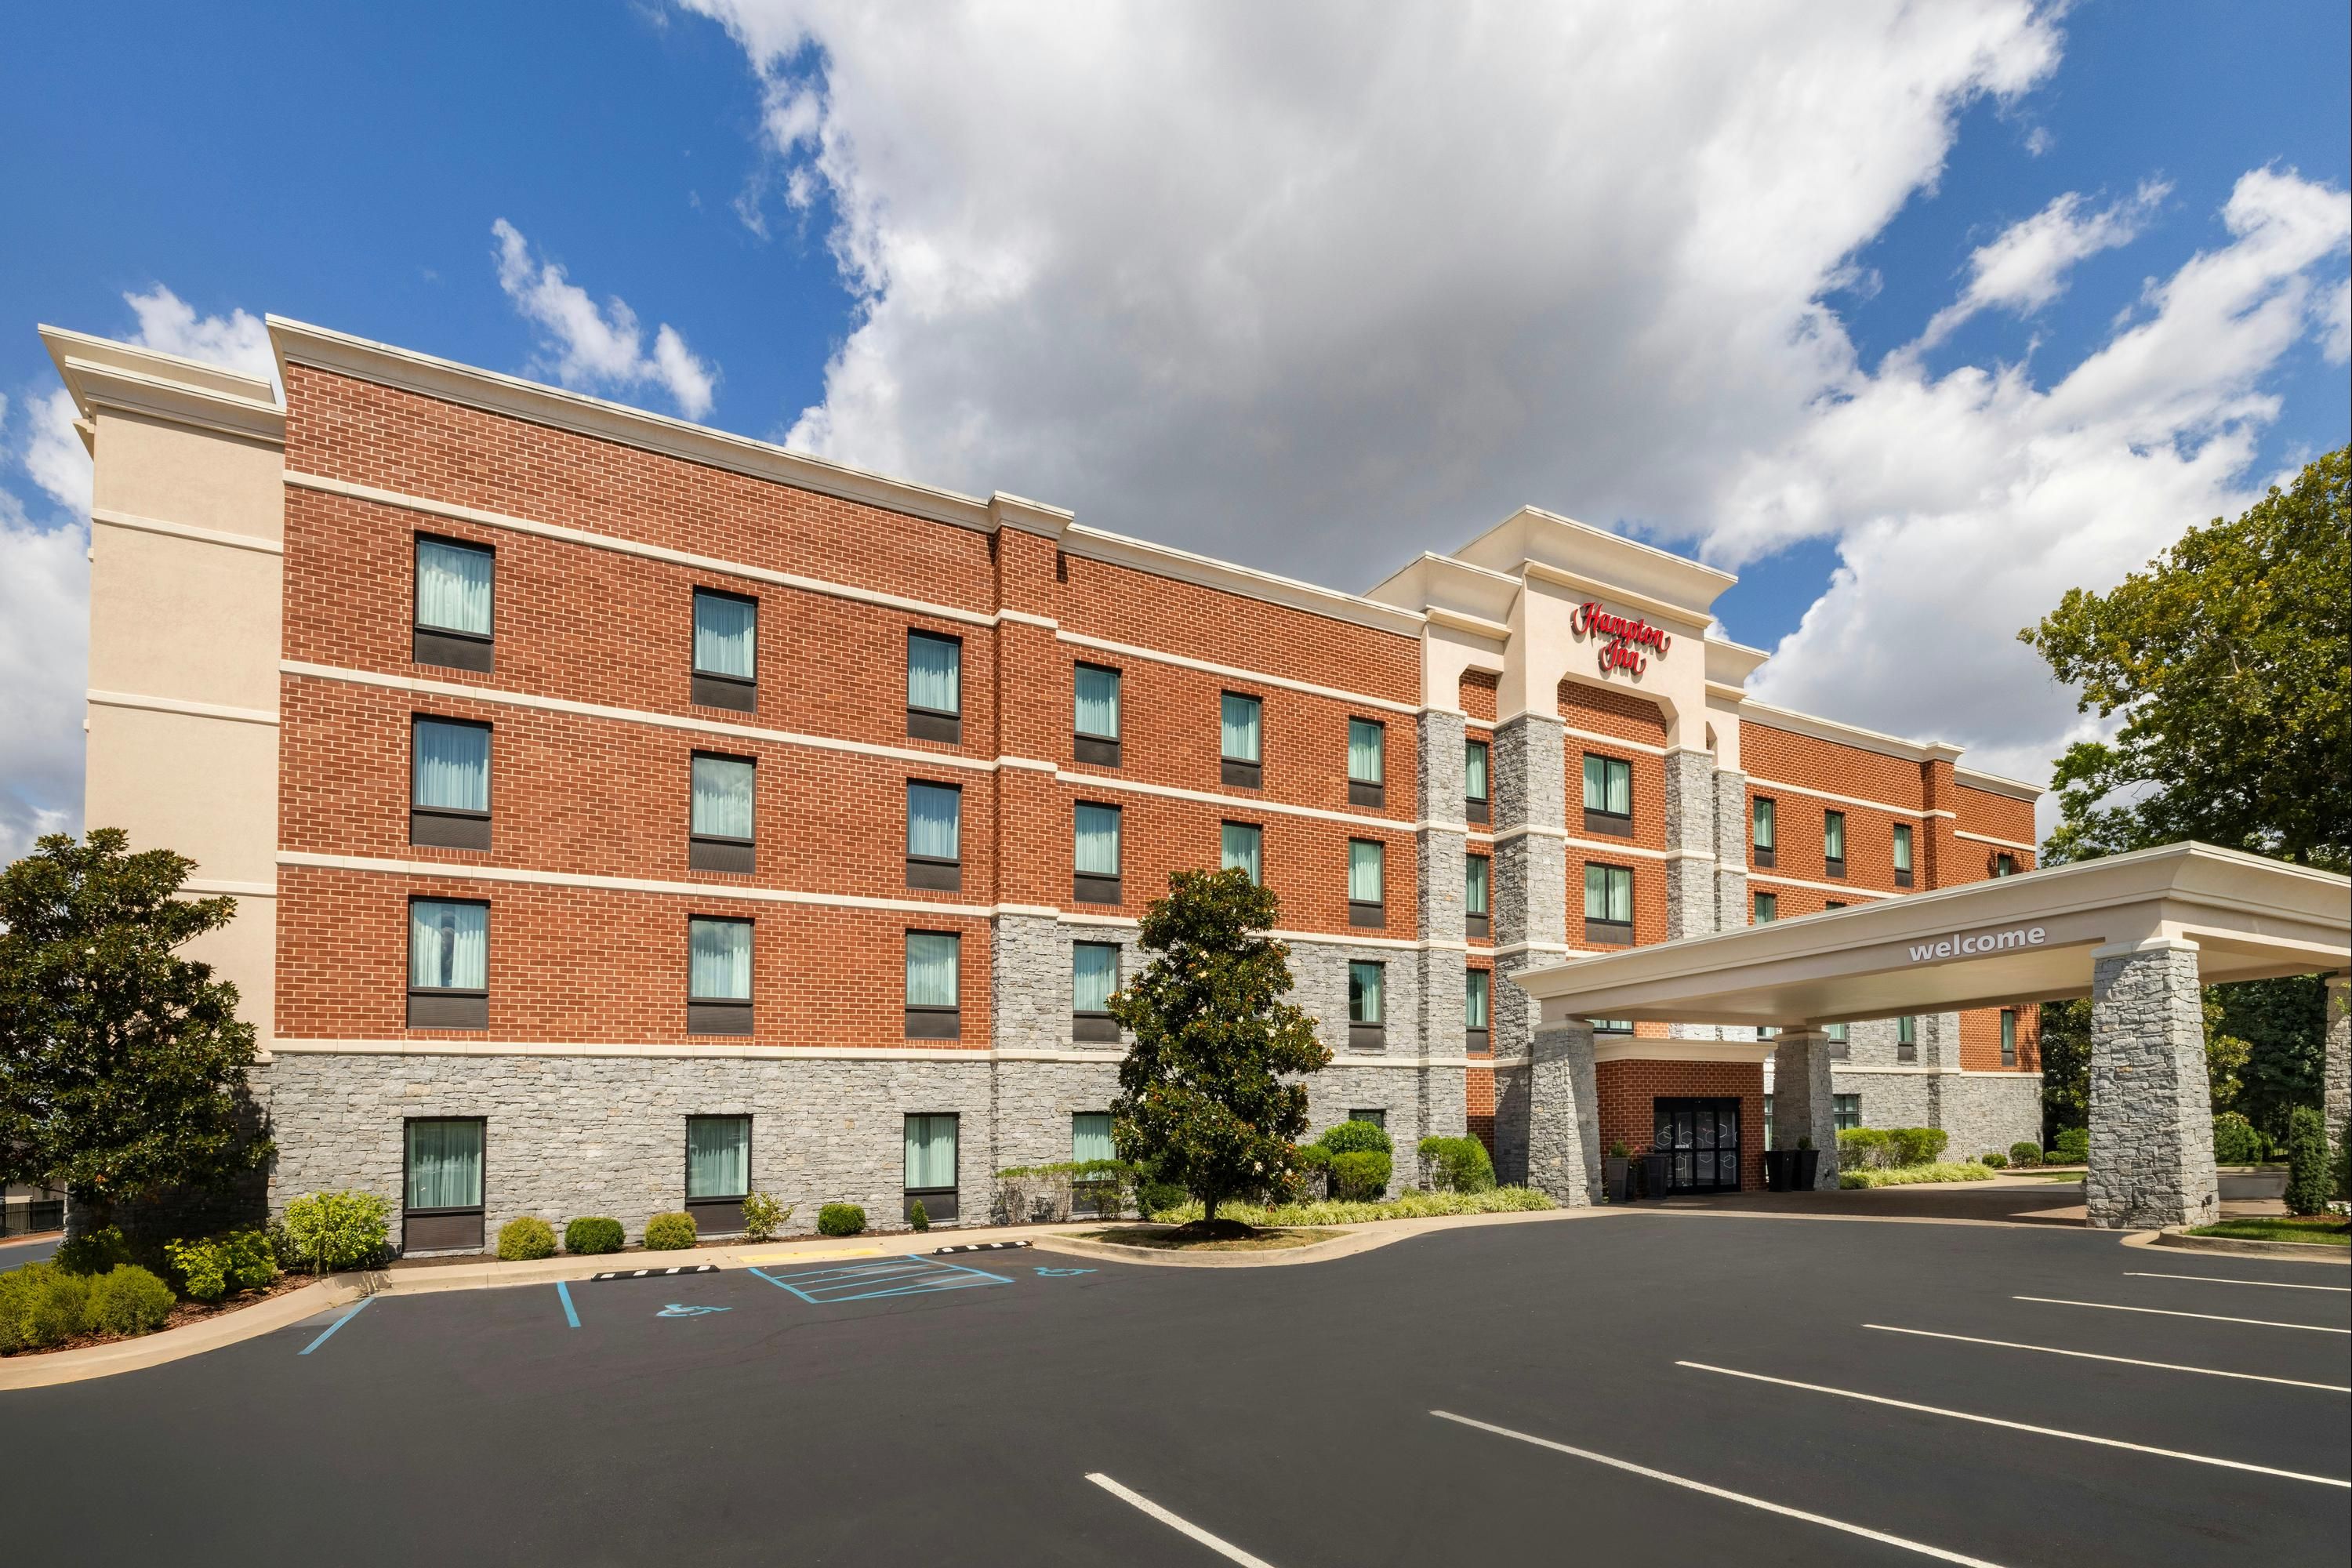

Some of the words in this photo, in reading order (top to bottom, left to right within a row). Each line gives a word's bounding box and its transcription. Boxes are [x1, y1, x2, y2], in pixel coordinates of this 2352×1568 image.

[1573, 602, 1671, 652] Hampton
[1600, 639, 1646, 675] Inn
[1909, 927, 2045, 961] welcome
